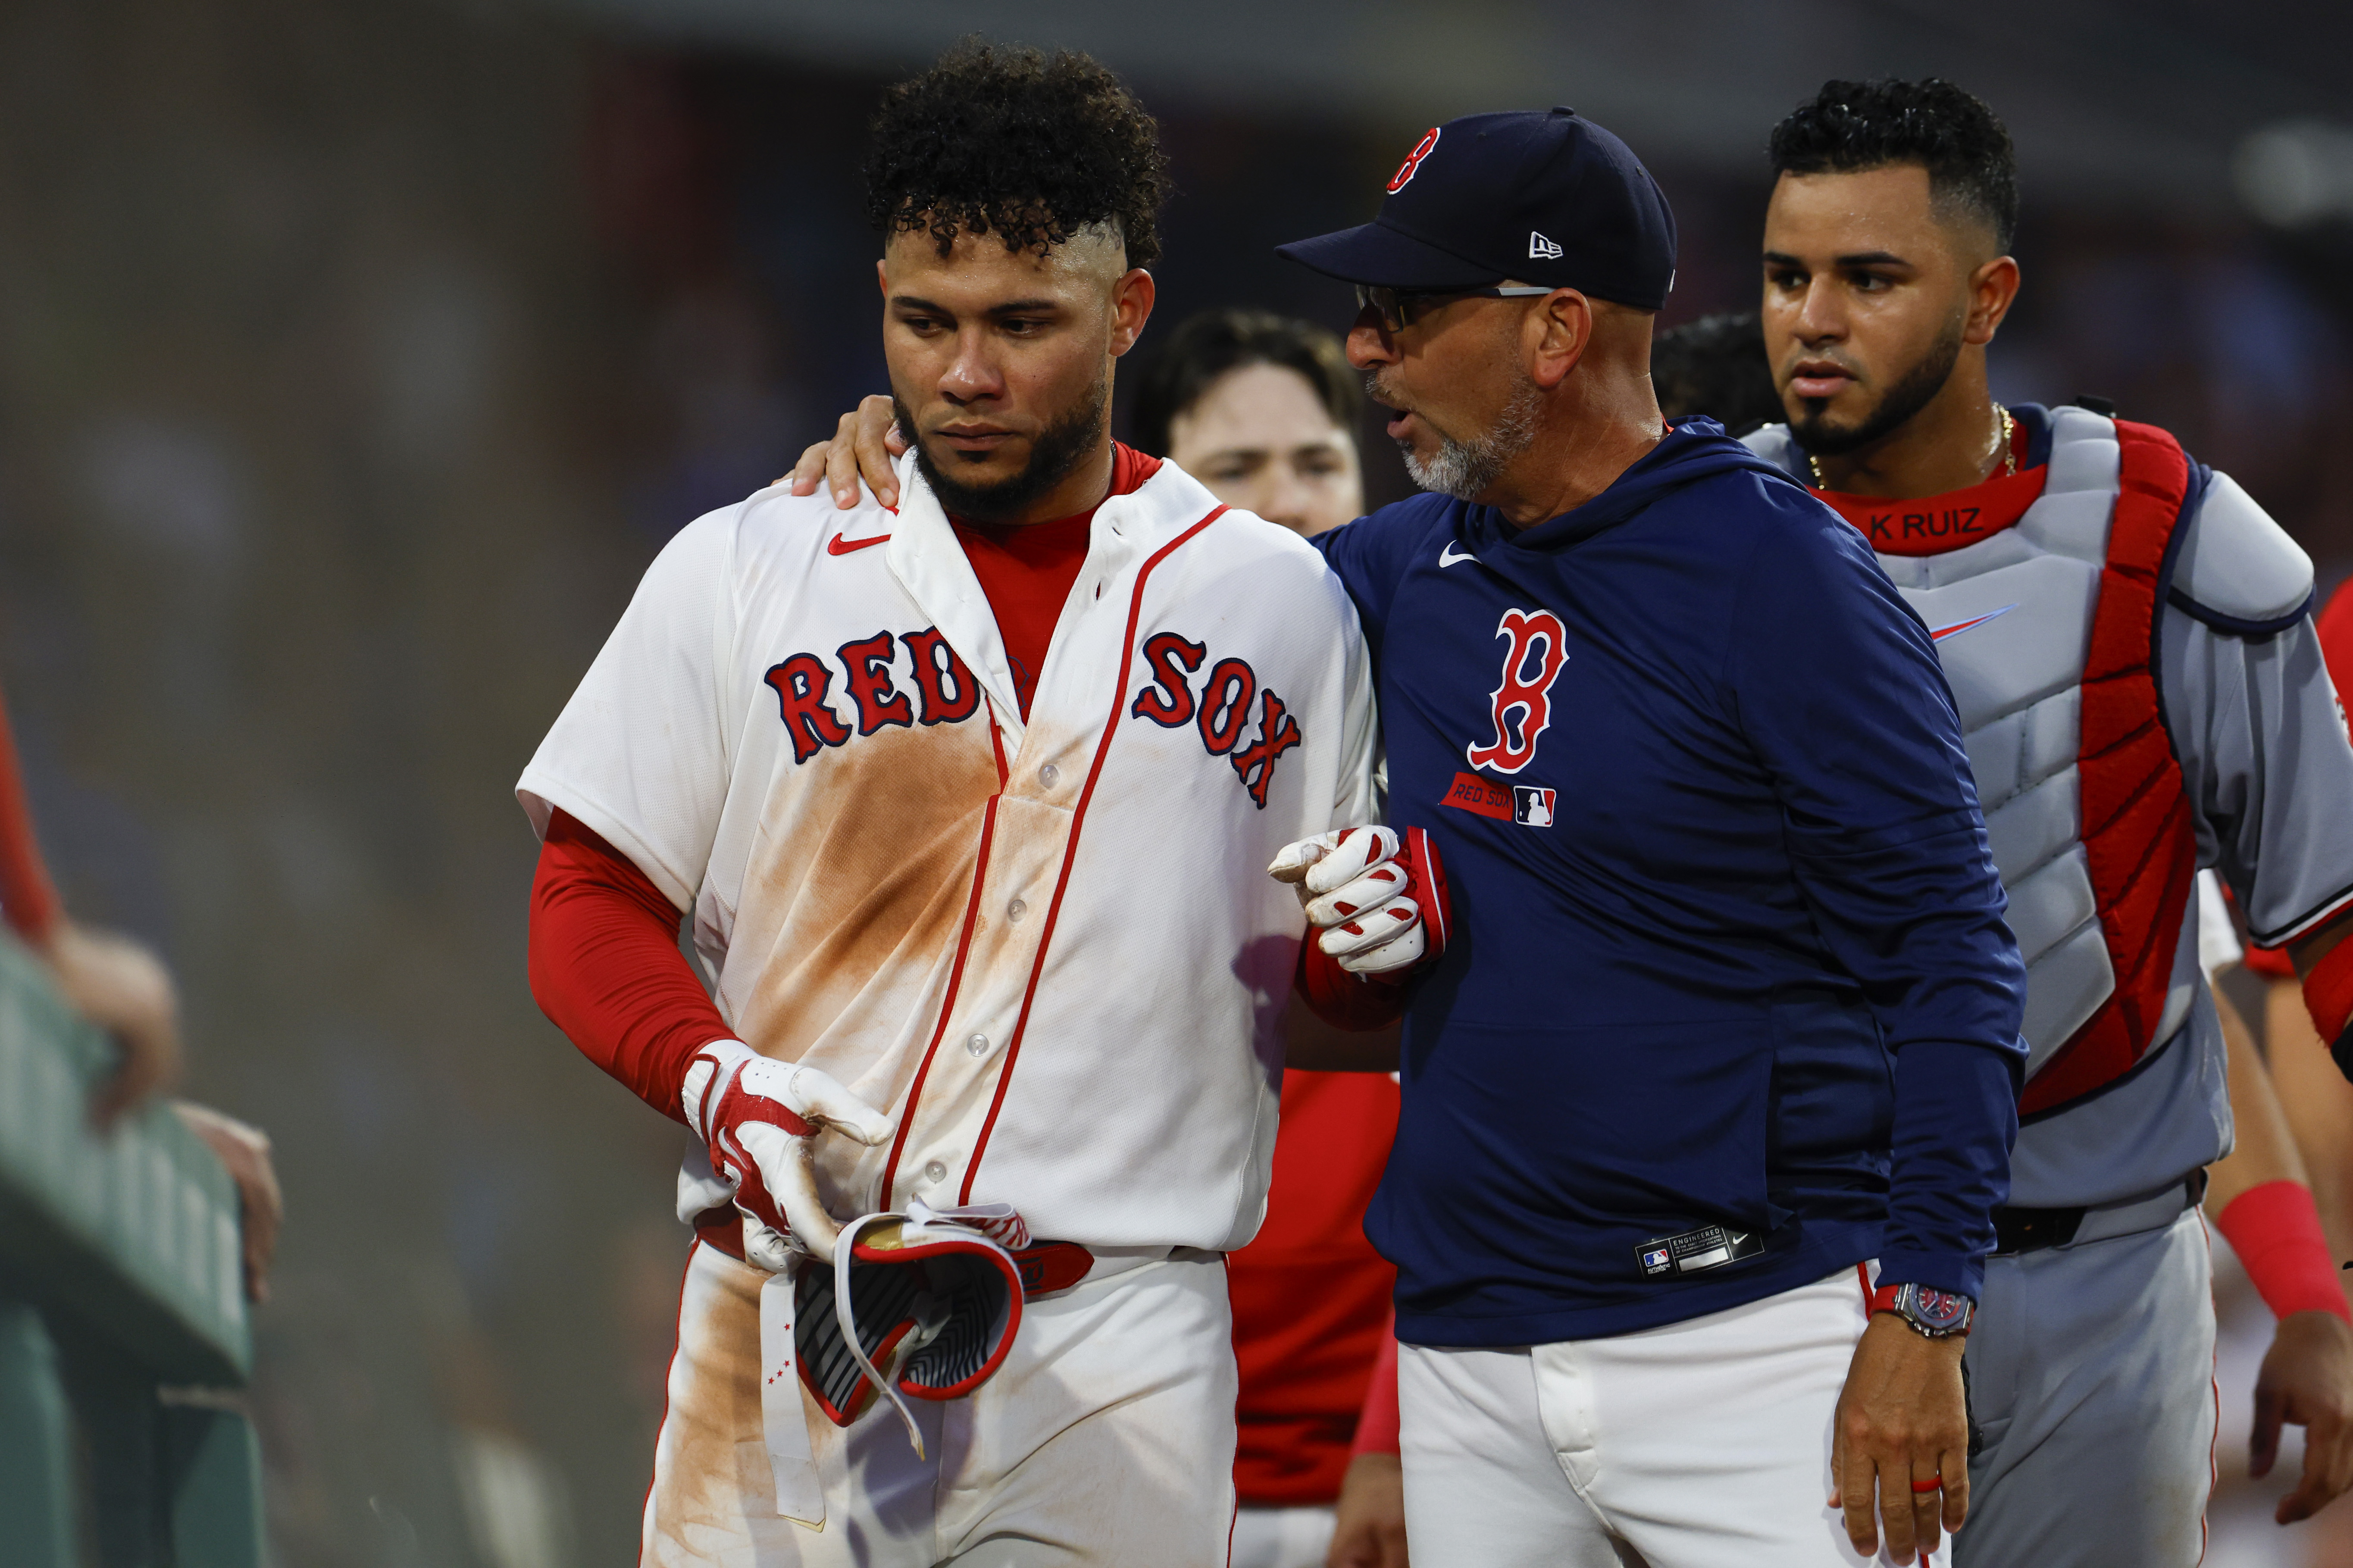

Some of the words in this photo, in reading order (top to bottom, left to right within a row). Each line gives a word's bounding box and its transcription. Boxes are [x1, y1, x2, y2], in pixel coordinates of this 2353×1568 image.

[1386, 127, 1441, 195] B
[1870, 515, 1893, 540] K
[1903, 508, 1983, 538] RUIZ
[1467, 608, 1570, 774] B
[764, 626, 981, 765] RED
[1132, 632, 1302, 810] SOX
[1453, 784, 1483, 803] RED
[1486, 790, 1510, 809] SOX
[1673, 1228, 1720, 1246] ENGINEERED
[1648, 1263, 1671, 1273] AUTHENTIC
